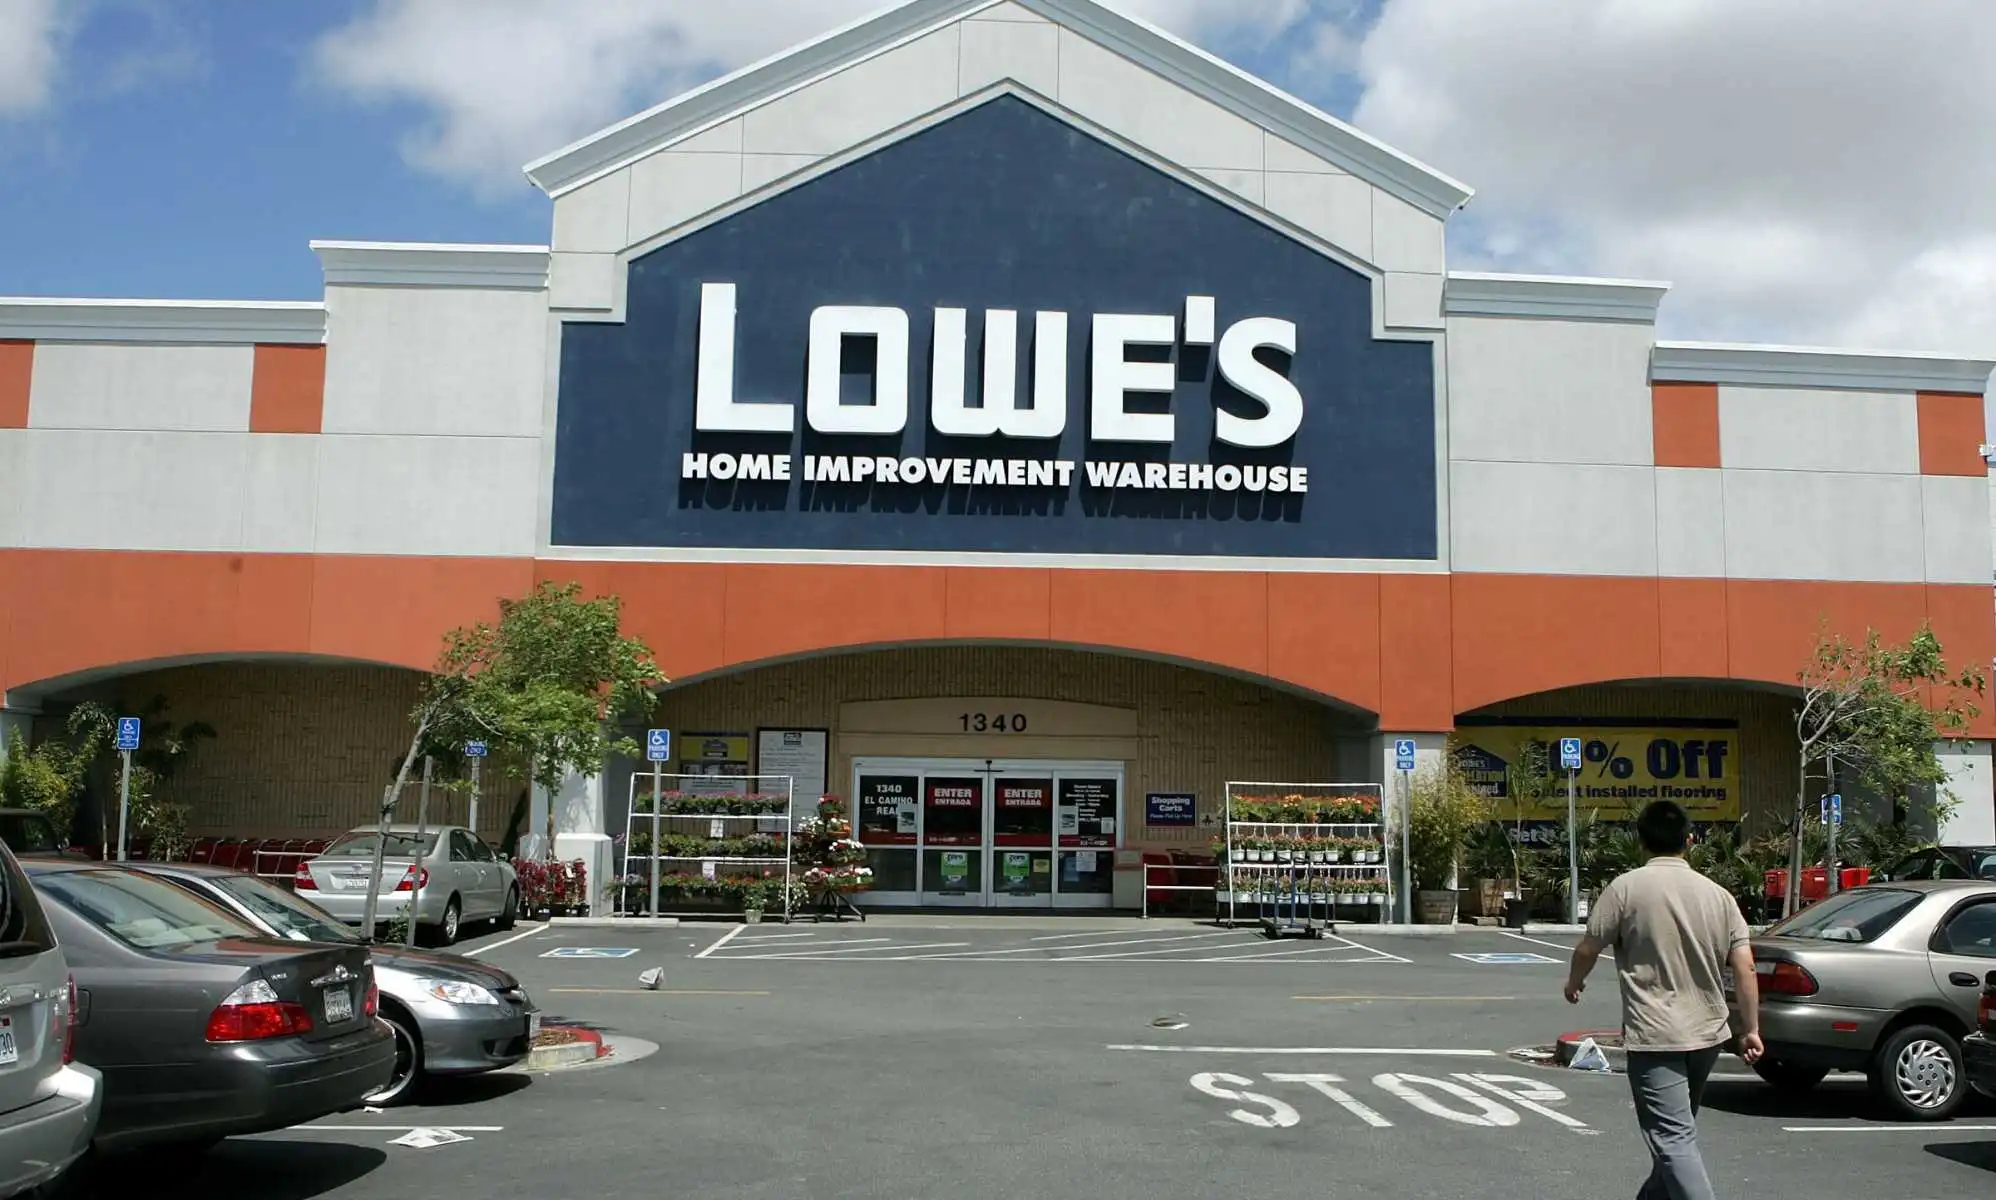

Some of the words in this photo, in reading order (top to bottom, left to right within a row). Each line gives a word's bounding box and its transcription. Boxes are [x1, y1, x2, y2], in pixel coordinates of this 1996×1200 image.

[695, 283, 1304, 448] LOWE'S
[682, 452, 791, 481] HOME
[803, 455, 1075, 487] IMPROVEMENT
[1086, 461, 1309, 493] WAREHOUSE
[959, 713, 1027, 732] 1340
[1647, 739, 1728, 779] Off
[876, 784, 902, 793] 1340
[934, 788, 972, 798] ENTER
[1004, 789, 1042, 798] ENTER
[1586, 785, 1657, 798] installed
[864, 796, 875, 804] EL
[878, 796, 913, 805] CAMINO
[935, 798, 972, 806] ENTRADA
[1151, 796, 1190, 806] Shopping
[876, 806, 898, 815] REA
[1189, 1072, 1593, 1129] STOP
